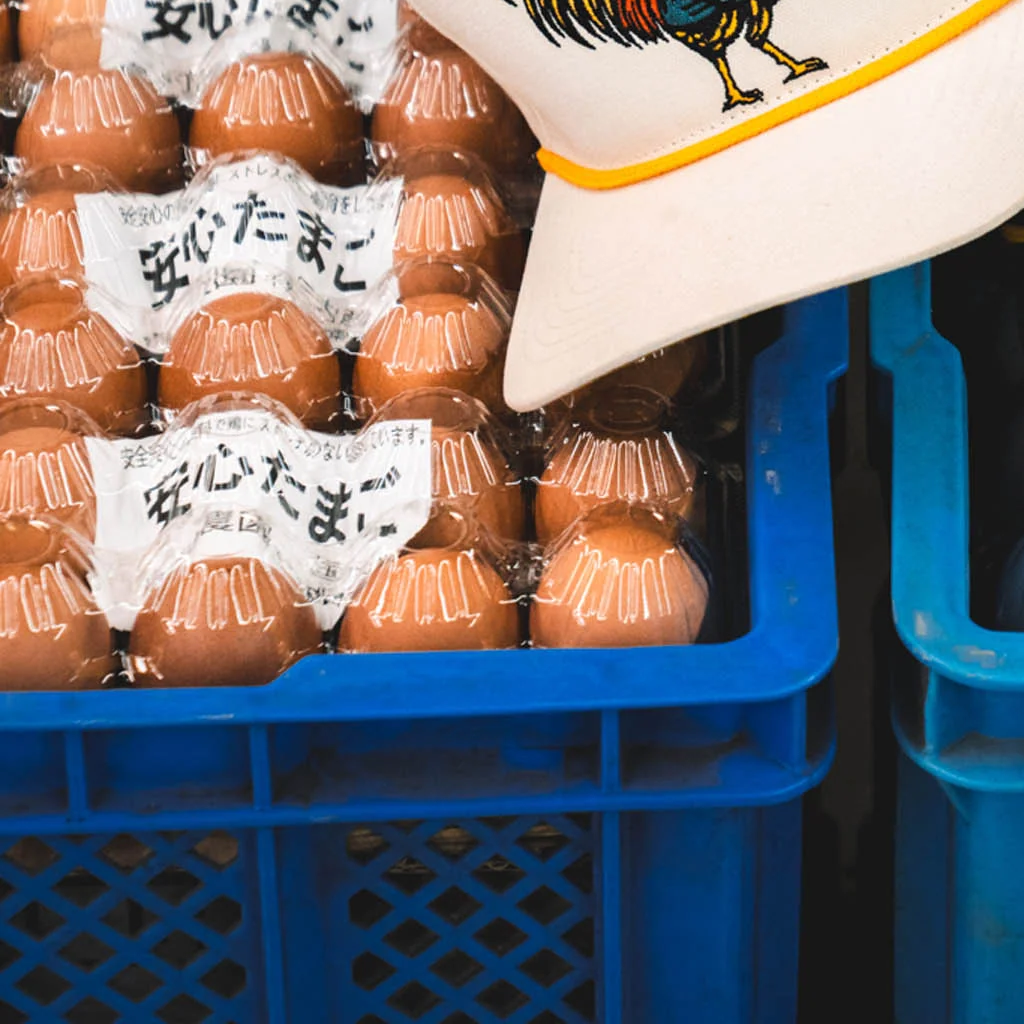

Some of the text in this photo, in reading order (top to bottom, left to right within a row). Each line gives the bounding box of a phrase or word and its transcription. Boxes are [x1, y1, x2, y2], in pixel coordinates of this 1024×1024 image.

[139, 191, 376, 309] 安心たまご
[143, 442, 401, 544] 安心たまご
